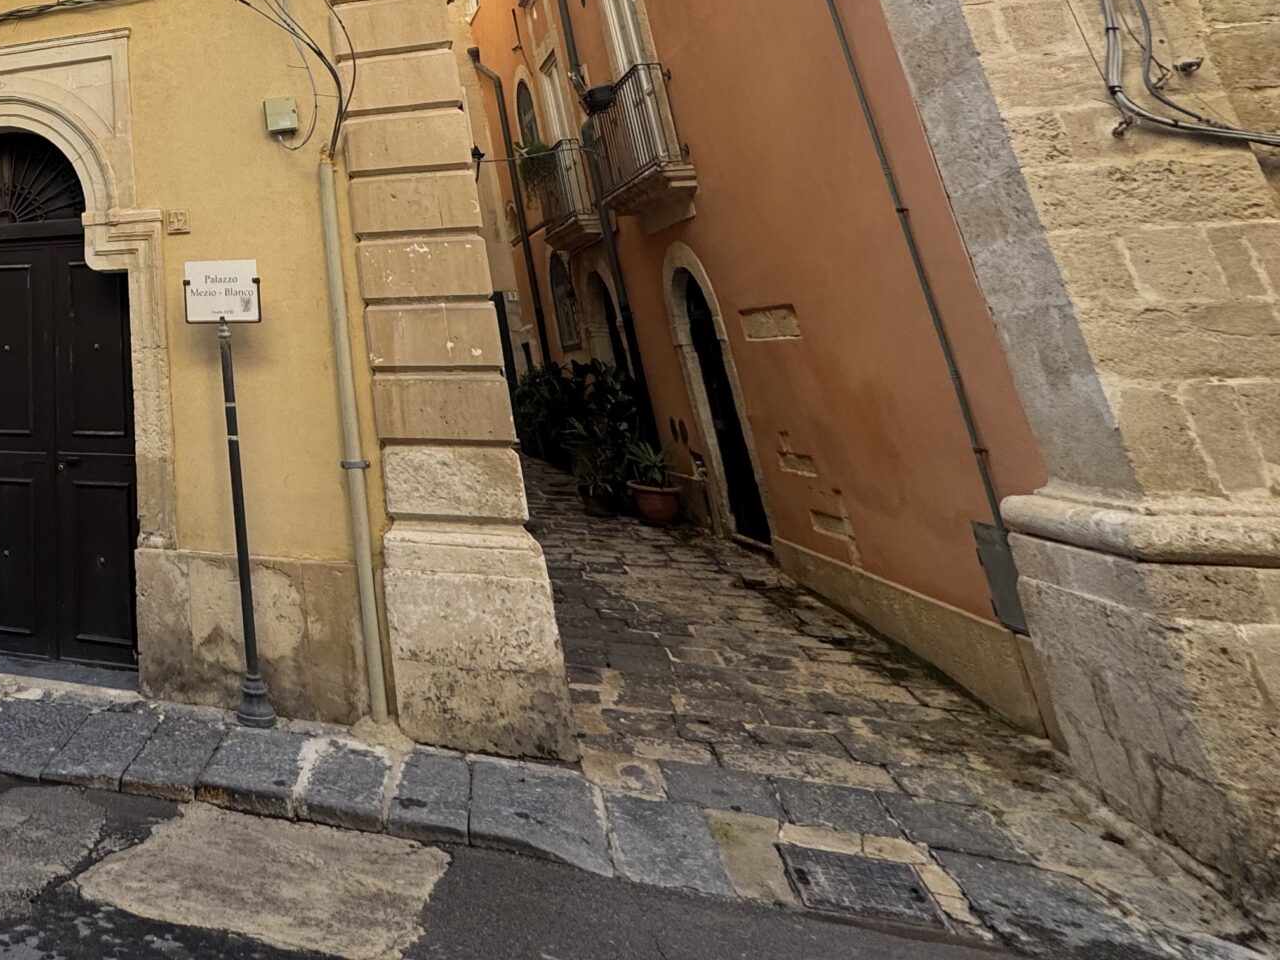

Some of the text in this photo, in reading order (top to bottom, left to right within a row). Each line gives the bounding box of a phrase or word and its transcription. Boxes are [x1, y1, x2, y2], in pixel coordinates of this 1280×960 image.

[204, 274, 238, 284] Palazzo
[190, 288, 217, 297] Mezio
[224, 287, 254, 297] Blanco
